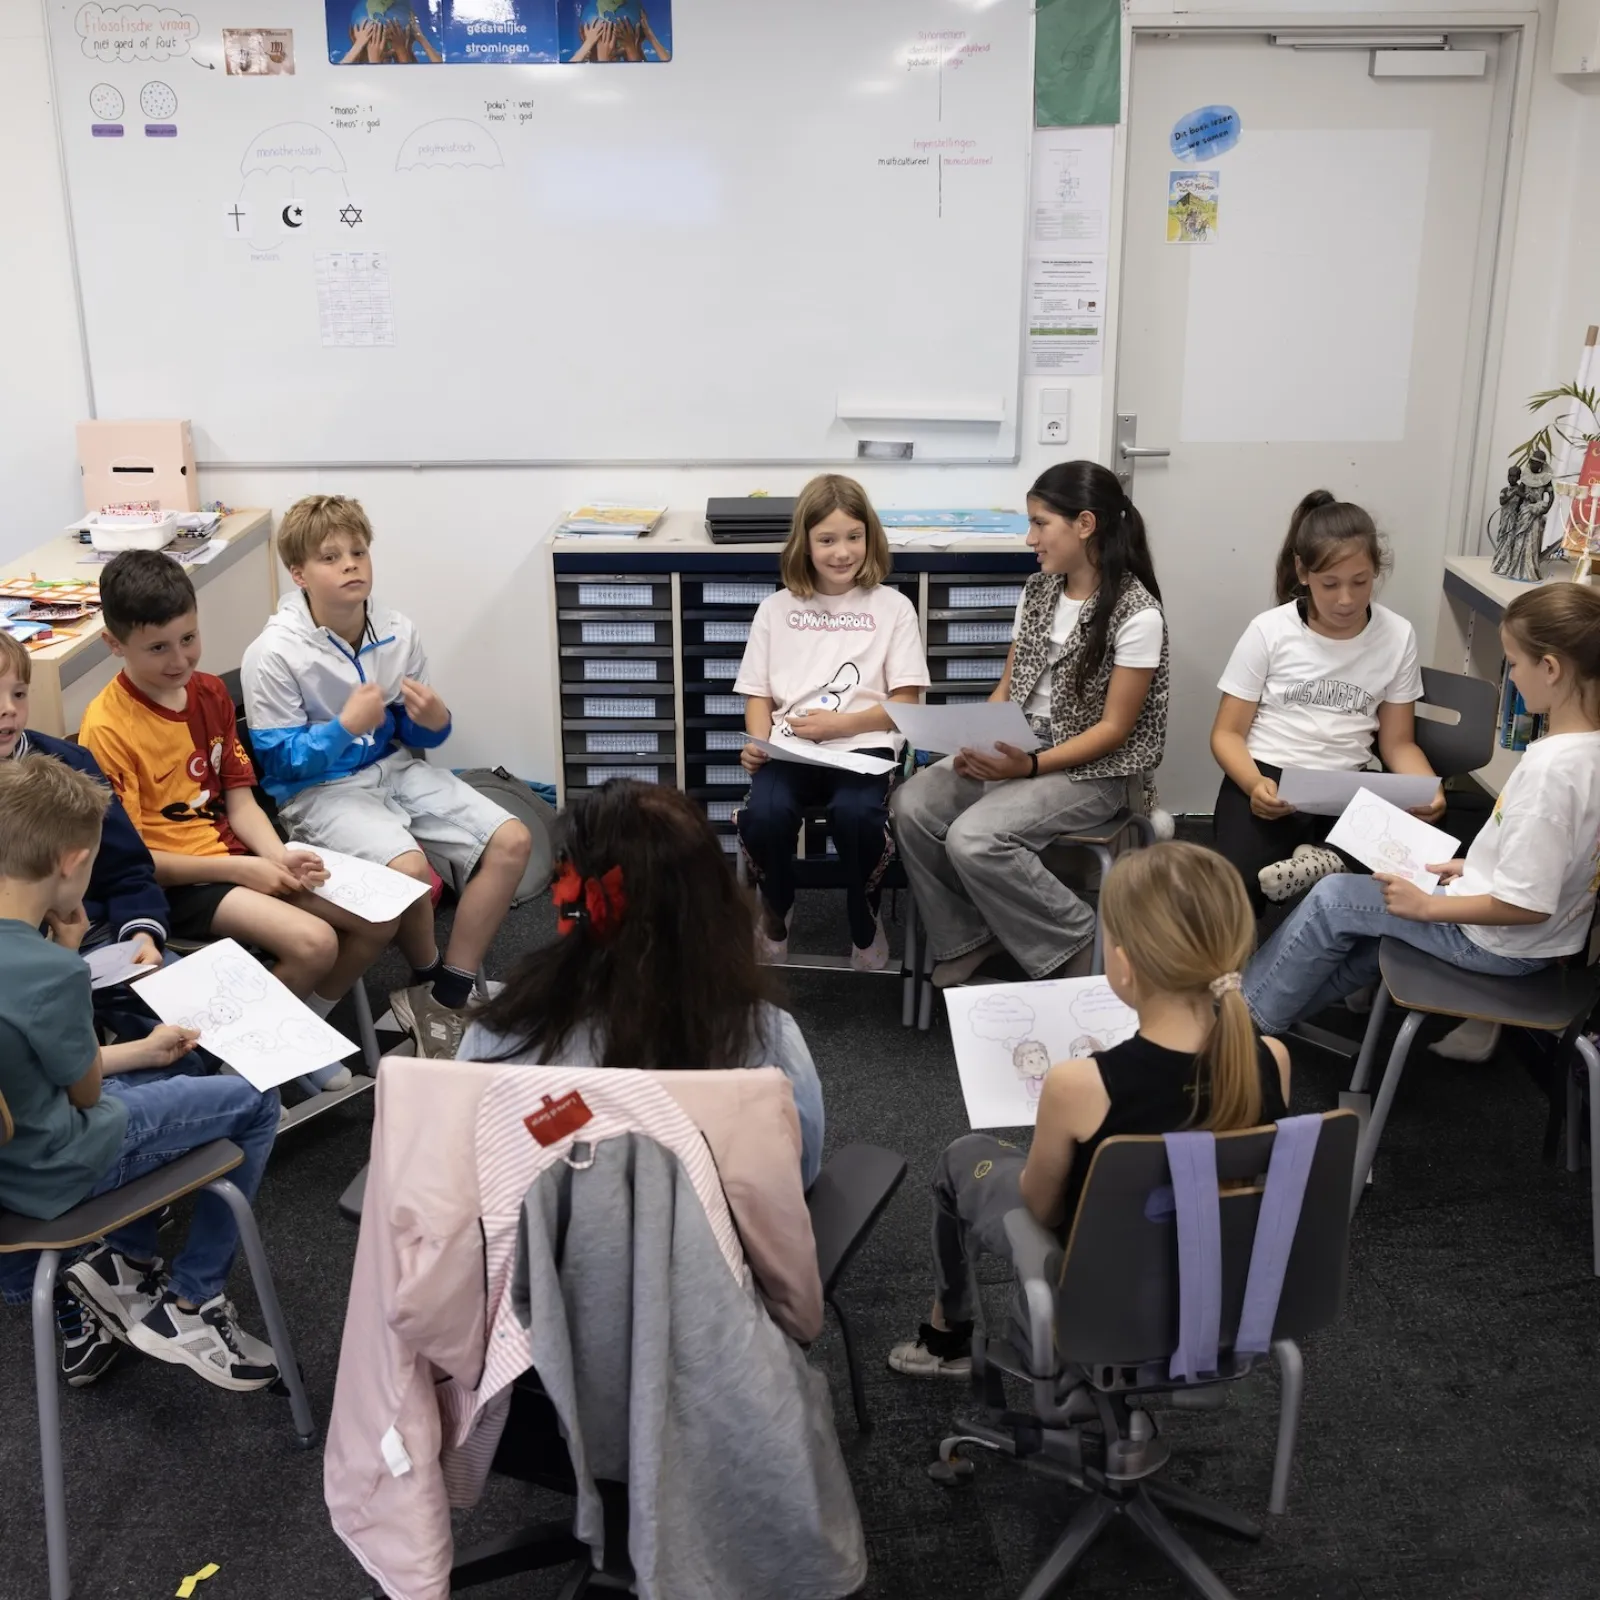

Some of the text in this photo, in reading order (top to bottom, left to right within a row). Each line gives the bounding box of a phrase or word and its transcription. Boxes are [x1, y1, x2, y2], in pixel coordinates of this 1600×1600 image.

[466, 20, 528, 36] geestelijke
[114, 38, 133, 55] goed
[139, 37, 150, 49] of
[156, 35, 177, 49] fout
[465, 41, 530, 54] stromingen
[1202, 130, 1229, 144] samen
[877, 156, 930, 166] multicultureel
[788, 611, 875, 630] CINNAMOROLL
[1283, 681, 1315, 706] LOS
